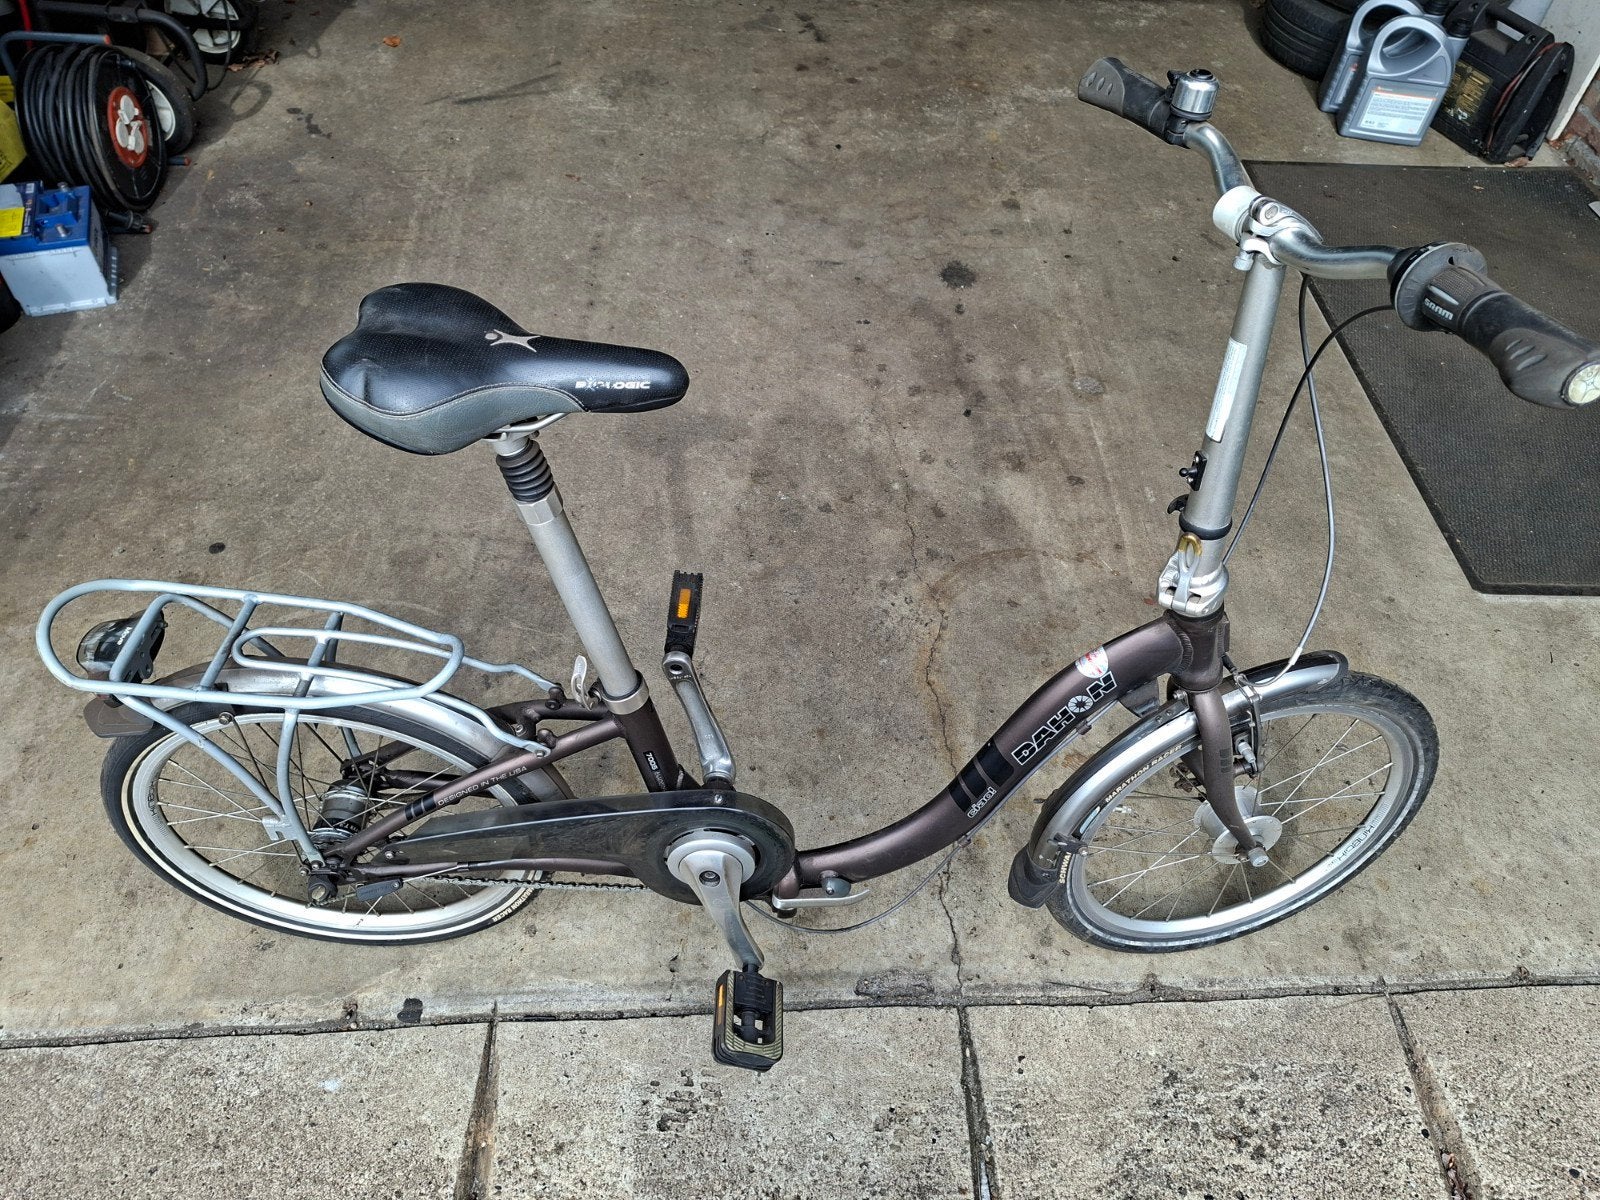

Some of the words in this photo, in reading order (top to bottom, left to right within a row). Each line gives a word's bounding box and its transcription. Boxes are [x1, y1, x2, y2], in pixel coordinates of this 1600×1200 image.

[1424, 298, 1454, 321] SRAM
[1011, 670, 1117, 766] DAHON
[437, 783, 479, 806] DESIGNED
[480, 779, 490, 788] IN
[490, 772, 508, 783] THE
[1105, 762, 1150, 804] MARATHON
[967, 786, 997, 818] ciao!
